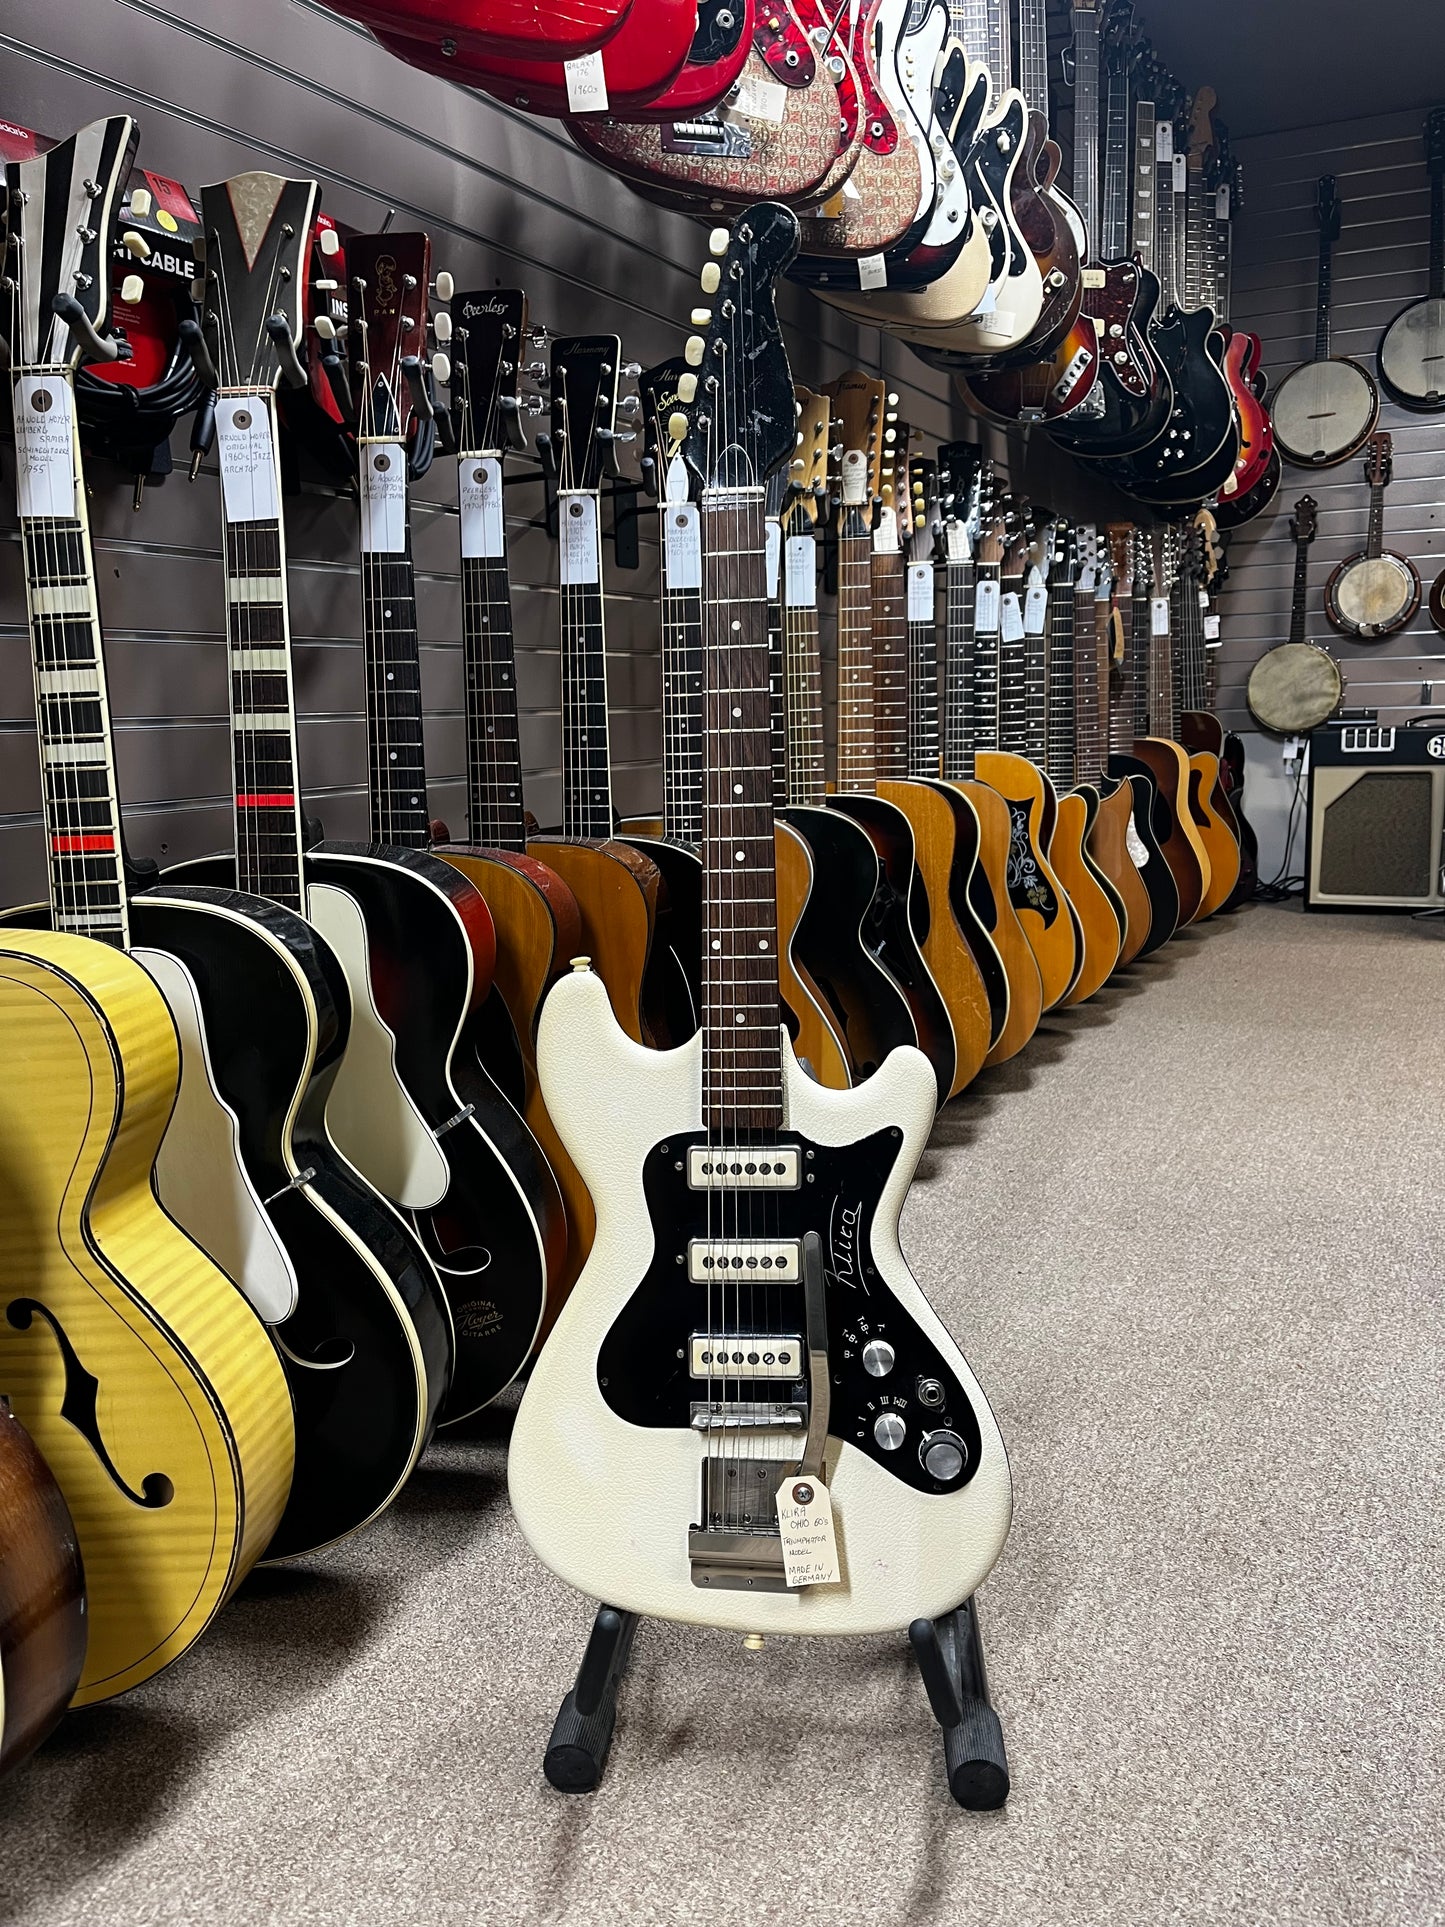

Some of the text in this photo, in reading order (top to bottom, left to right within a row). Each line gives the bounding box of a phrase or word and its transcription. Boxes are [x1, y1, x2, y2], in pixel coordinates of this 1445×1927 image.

[152, 176, 172, 195] 15
[463, 296, 509, 319] Peerless
[563, 343, 609, 358] Harmony
[781, 1506, 806, 1520] KLIRA
[790, 1517, 829, 1529] OHIO 60's
[789, 1563, 824, 1575] MADE IN
[792, 1570, 833, 1584] GERMANY
